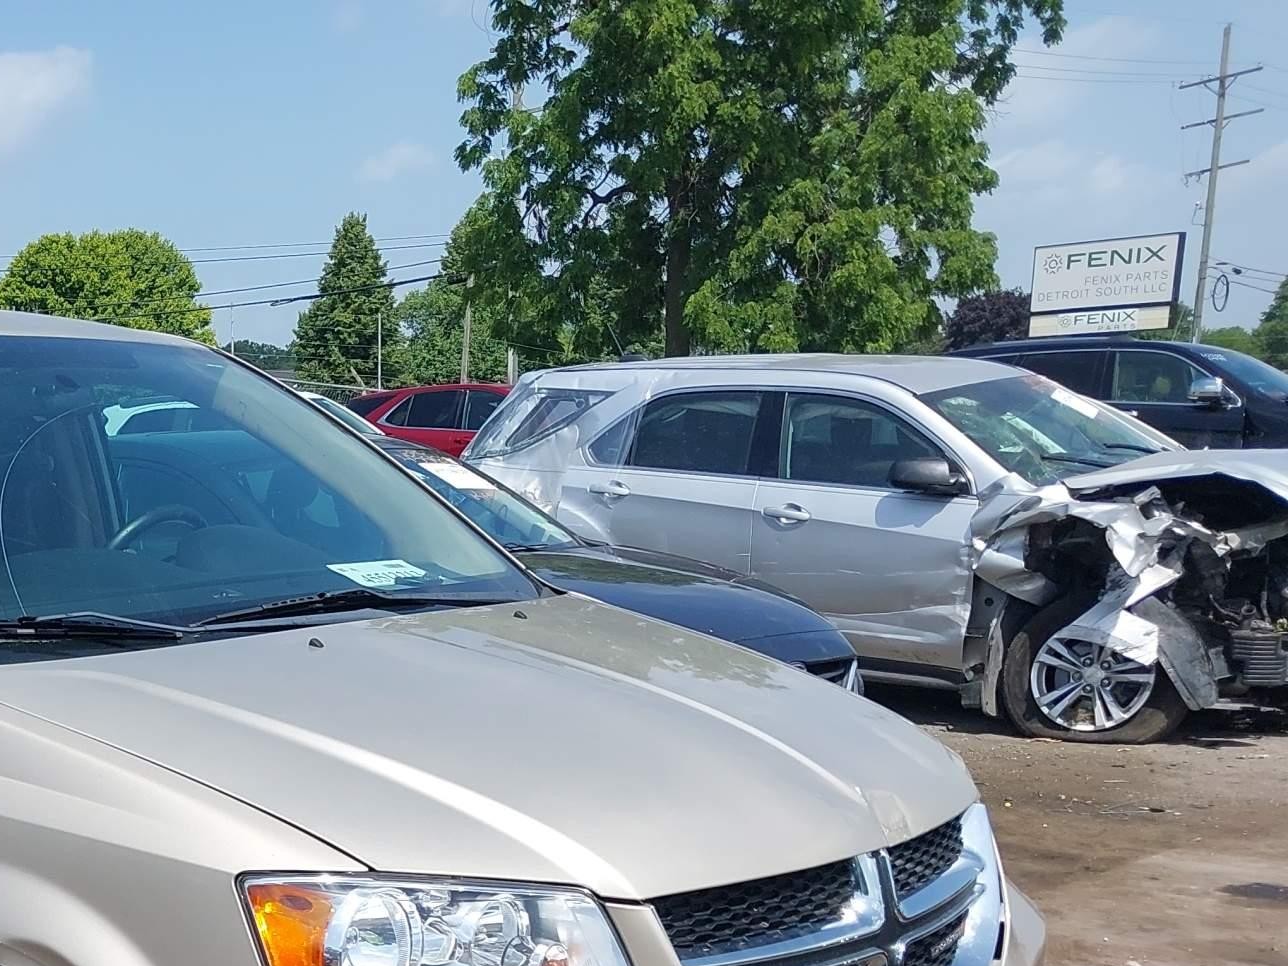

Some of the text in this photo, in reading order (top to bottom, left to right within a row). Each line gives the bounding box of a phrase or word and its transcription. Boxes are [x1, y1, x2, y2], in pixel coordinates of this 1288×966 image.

[1066, 244, 1168, 270] FENIX
[1084, 270, 1169, 286] FENIX PARTS
[1037, 282, 1168, 302] DETROIT SOUTH LLC
[1073, 310, 1137, 326] FENIX
[1096, 323, 1136, 331] PARTS
